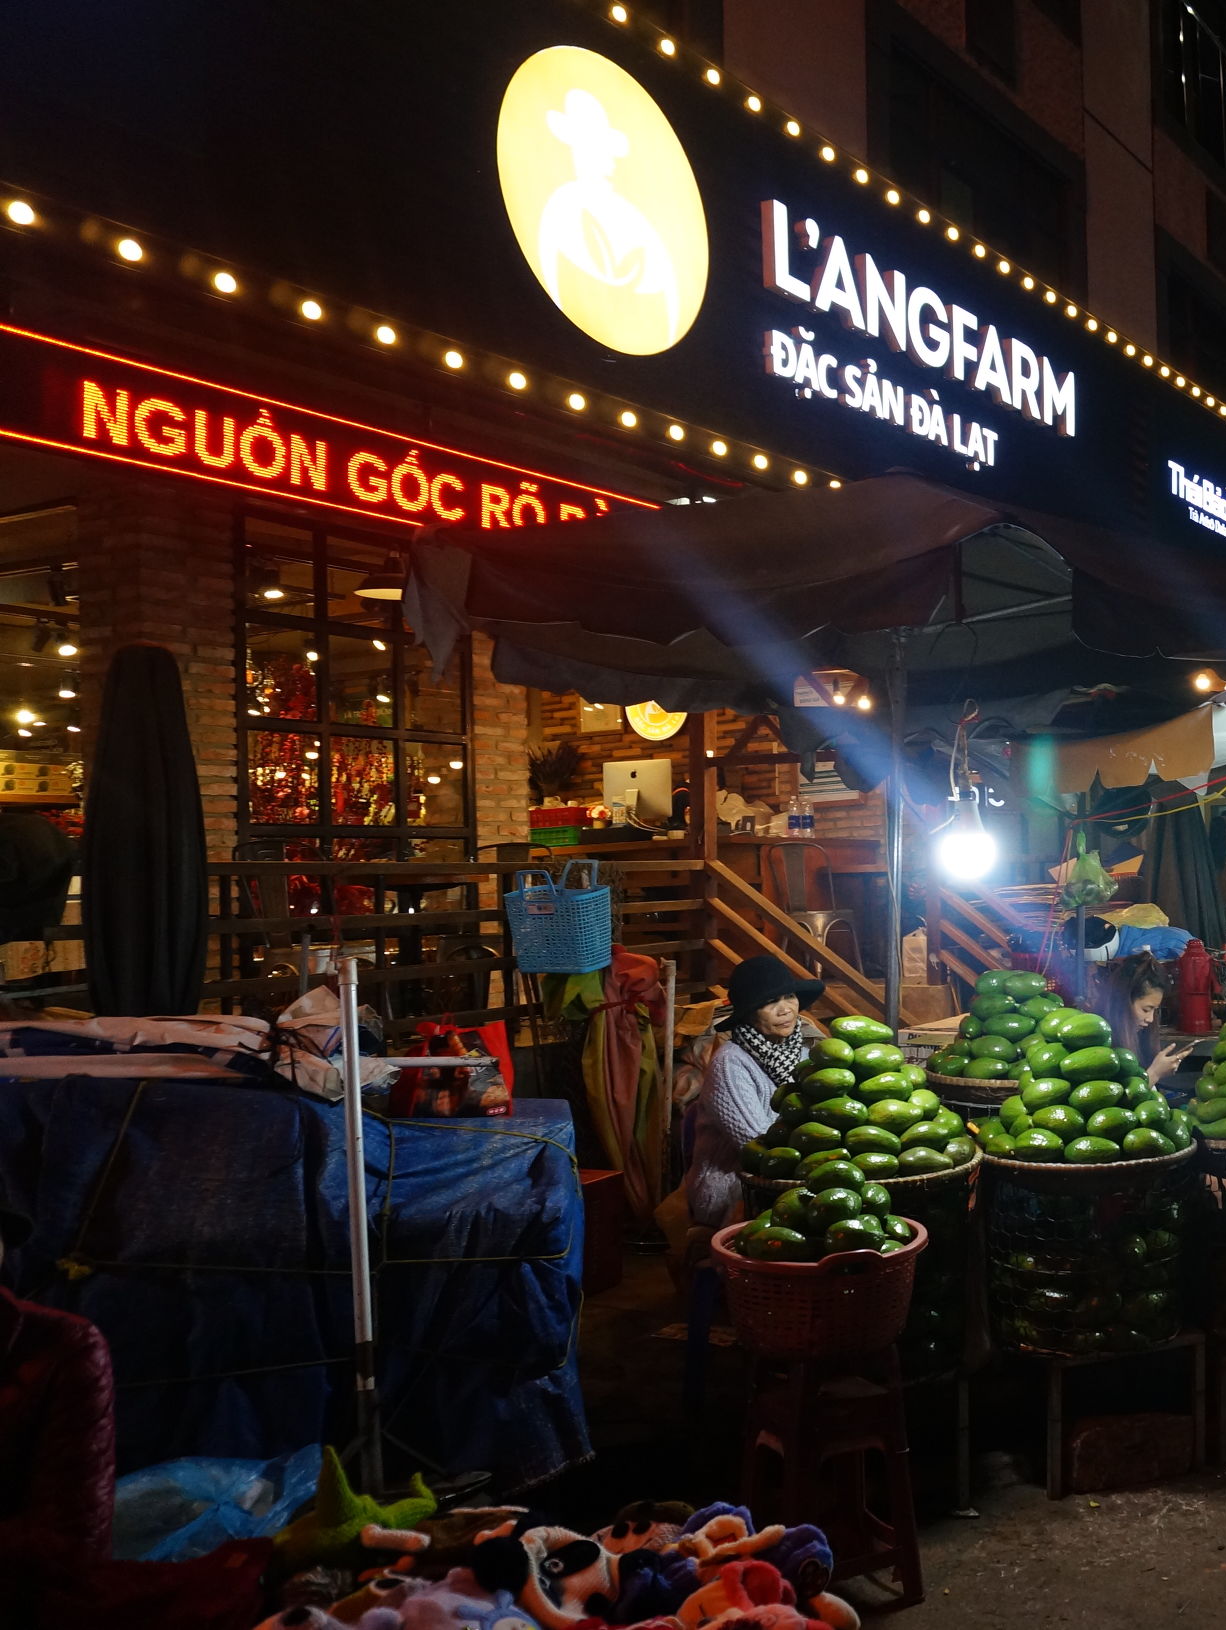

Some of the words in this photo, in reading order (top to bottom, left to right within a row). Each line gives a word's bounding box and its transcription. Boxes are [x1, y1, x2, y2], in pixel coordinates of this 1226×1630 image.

[761, 198, 1076, 438] L'ANGFARM
[82, 379, 329, 491] NGUỒN
[347, 449, 466, 522] GỐC
[764, 325, 838, 399] ĐẶC
[839, 358, 905, 427] SẢN
[906, 389, 949, 447] ĐÀ
[950, 413, 999, 471] LẠT
